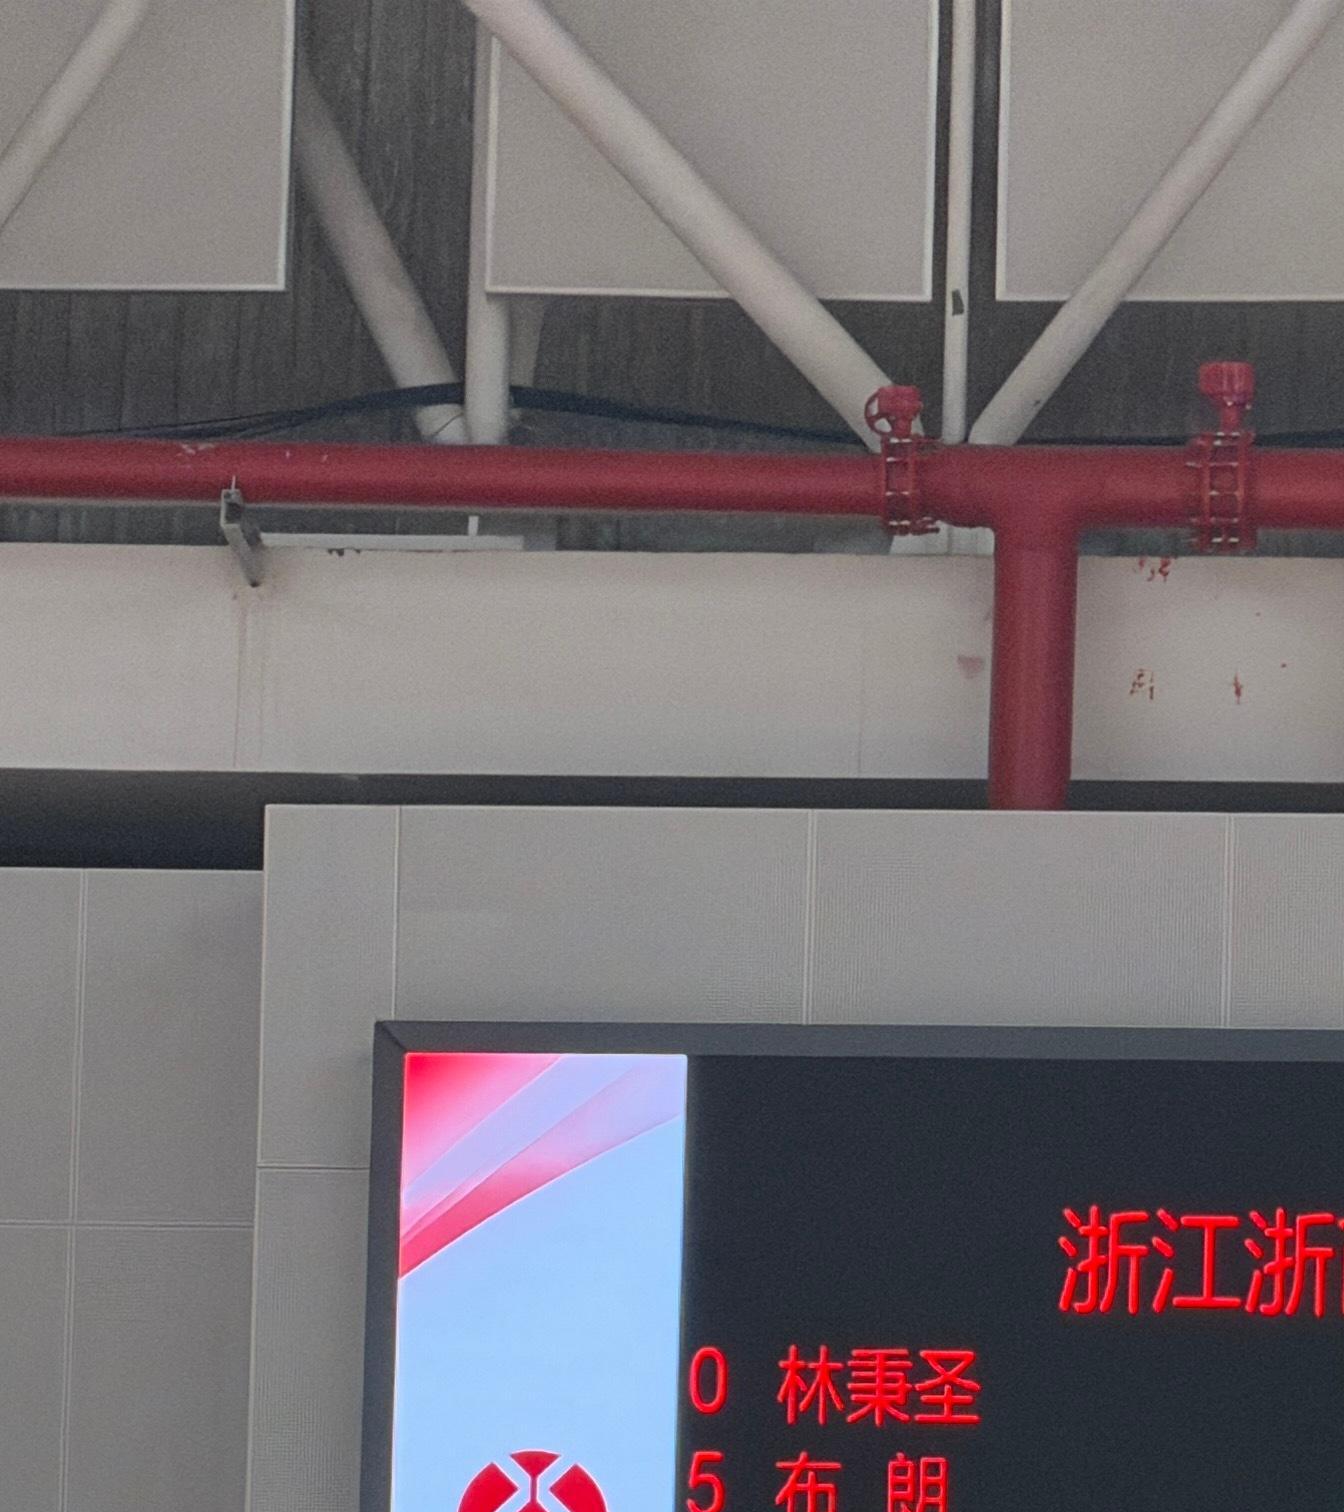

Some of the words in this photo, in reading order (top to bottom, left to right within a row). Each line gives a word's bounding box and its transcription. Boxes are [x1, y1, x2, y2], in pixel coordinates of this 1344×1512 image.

[690, 1344, 730, 1416] 0
[775, 1343, 983, 1429] 林秉圣
